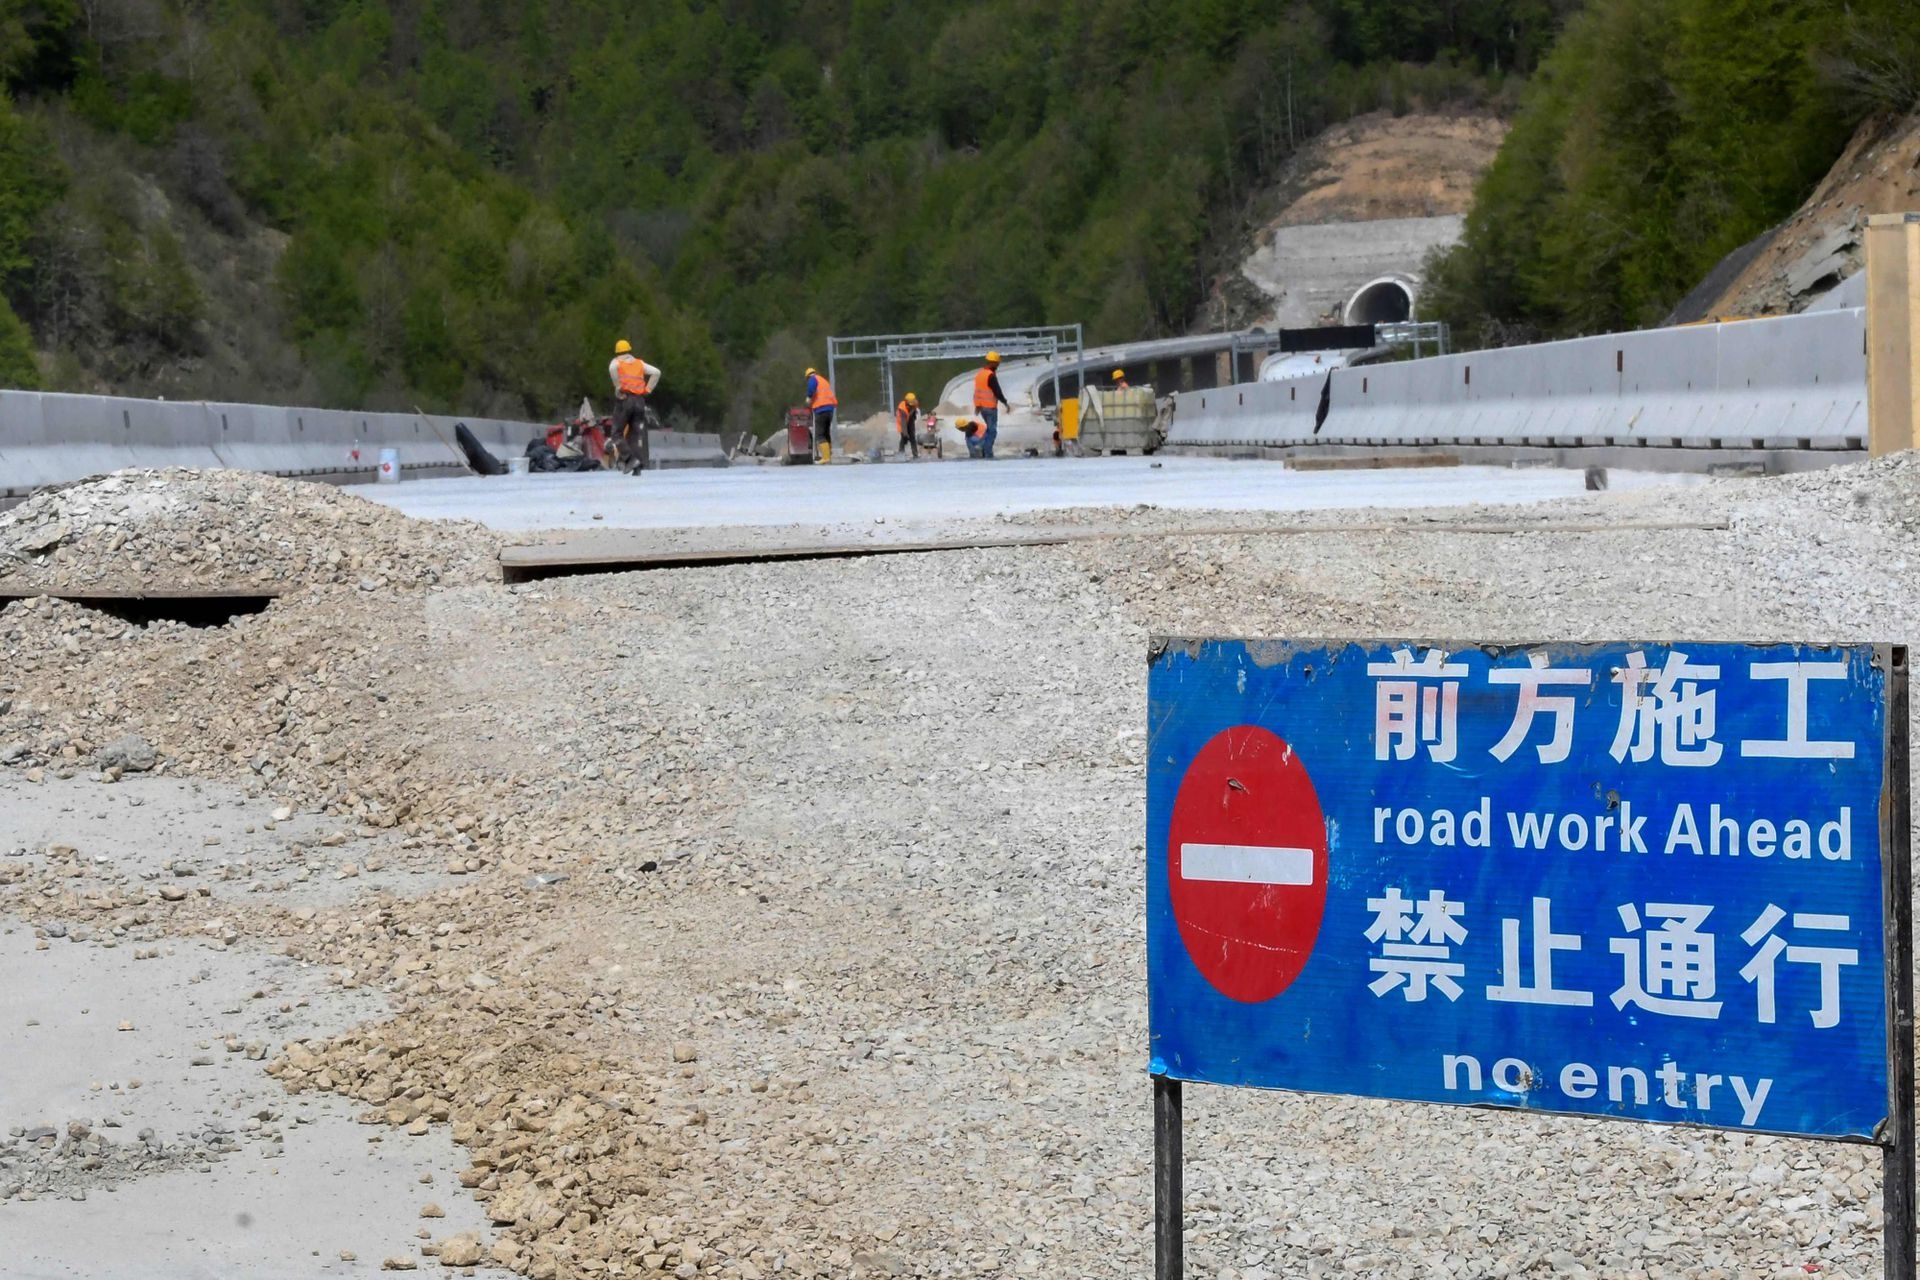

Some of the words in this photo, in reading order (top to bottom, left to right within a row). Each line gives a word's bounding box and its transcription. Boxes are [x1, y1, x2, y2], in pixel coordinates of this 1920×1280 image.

[1367, 649, 1856, 767] 前方施工
[1374, 796, 1491, 848] road
[1507, 801, 1647, 854] work
[1664, 803, 1852, 861] Ahead
[1364, 888, 1859, 1029] 禁止通行
[1442, 1054, 1533, 1094] no
[1559, 1059, 1774, 1126] entry
